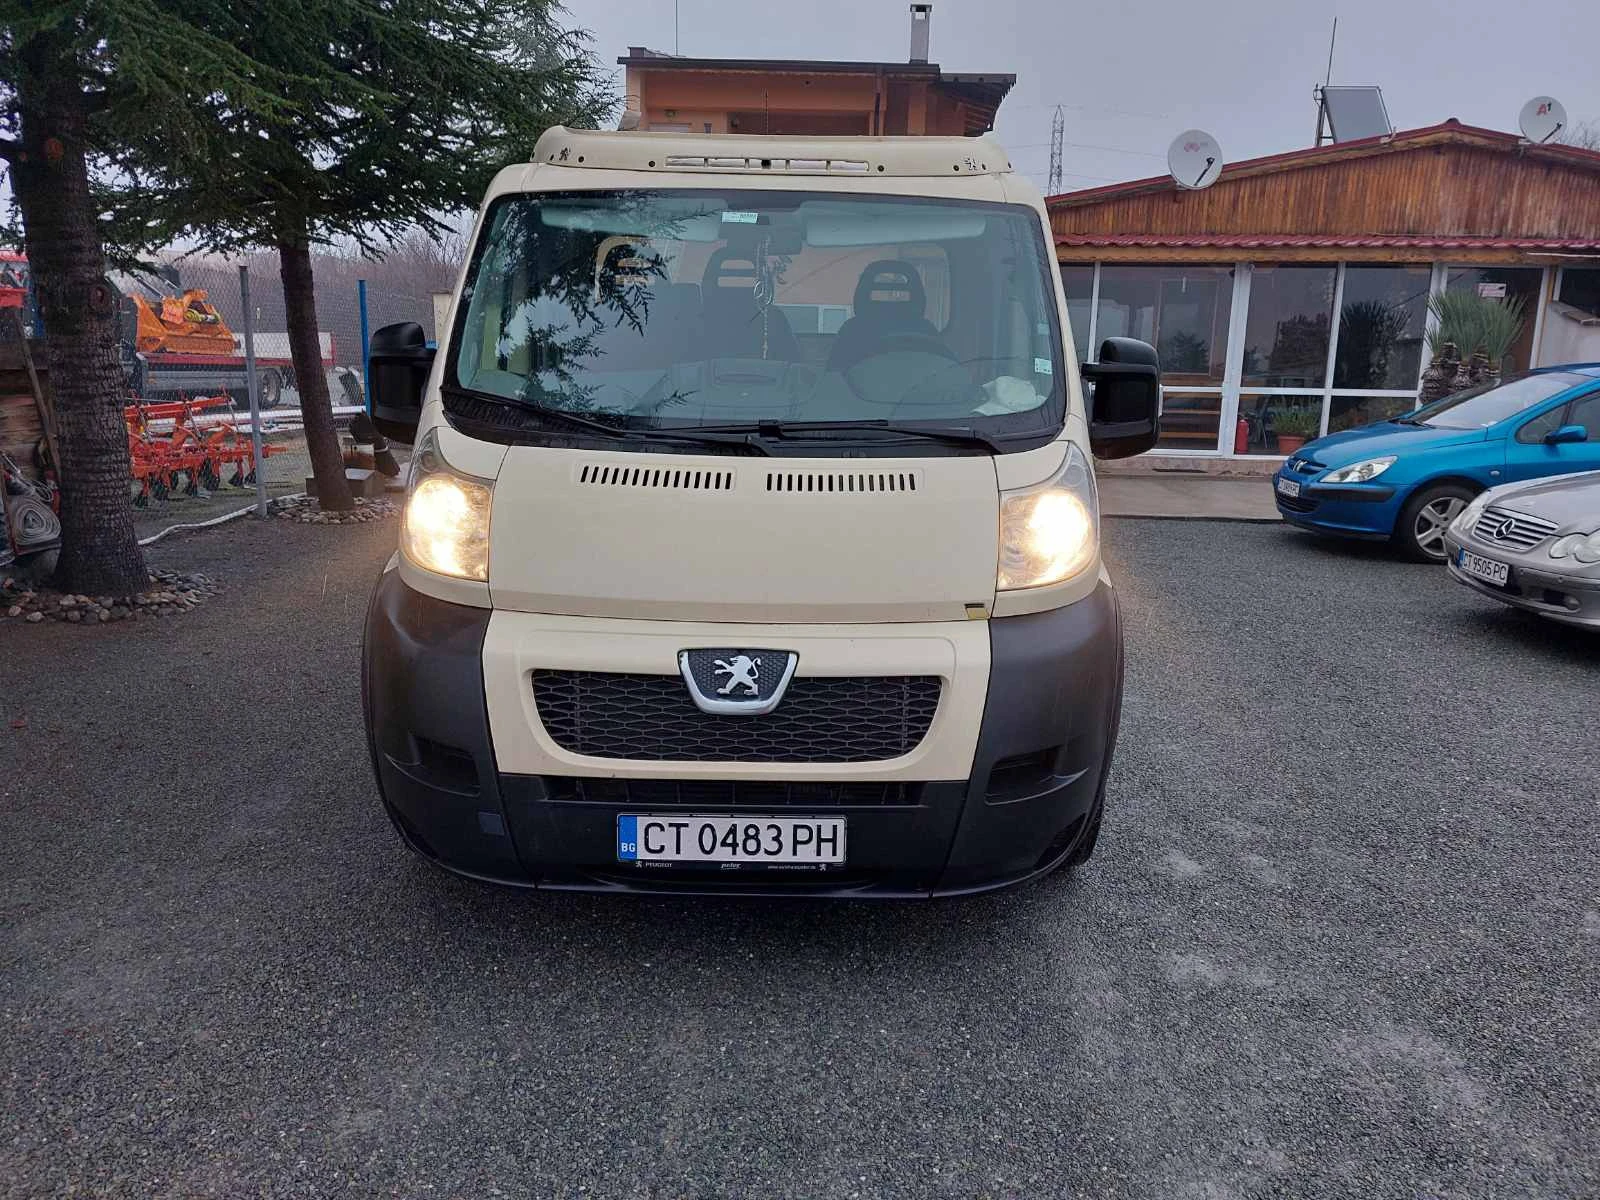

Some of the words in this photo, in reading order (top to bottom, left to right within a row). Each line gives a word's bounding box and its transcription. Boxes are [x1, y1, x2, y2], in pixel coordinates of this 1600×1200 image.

[1536, 102, 1552, 116] A1
[1473, 557, 1492, 576] 9505
[1493, 563, 1507, 580] PC
[621, 842, 636, 852] BG
[643, 822, 689, 855] CT
[698, 823, 784, 856] 0483
[792, 824, 838, 857] PH
